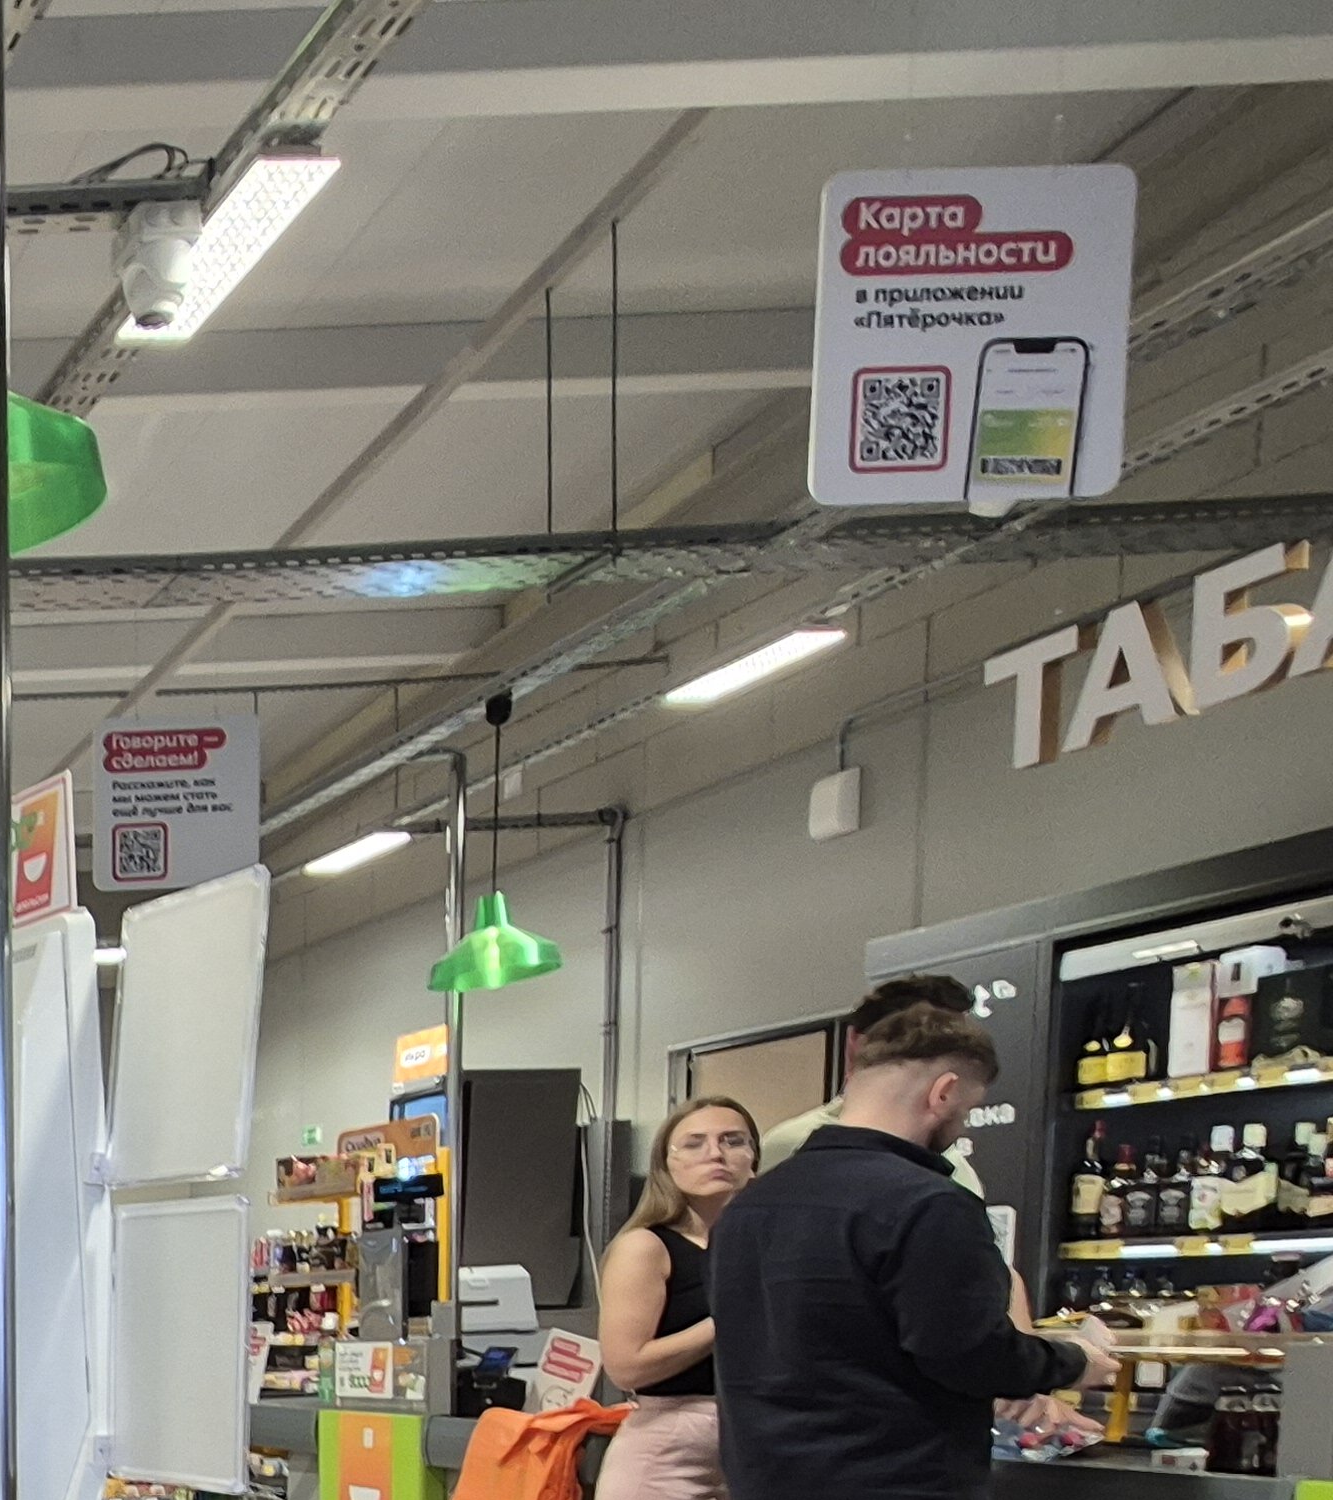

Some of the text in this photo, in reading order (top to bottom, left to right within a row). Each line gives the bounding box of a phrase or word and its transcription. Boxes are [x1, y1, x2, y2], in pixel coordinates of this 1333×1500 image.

[859, 200, 965, 236] Карта
[855, 240, 1057, 269] лояльности
[855, 284, 1025, 308] в приложении
[854, 307, 1005, 332] «Пятёрочка»
[112, 732, 198, 751] Говорите
[112, 751, 199, 770] сделаем!
